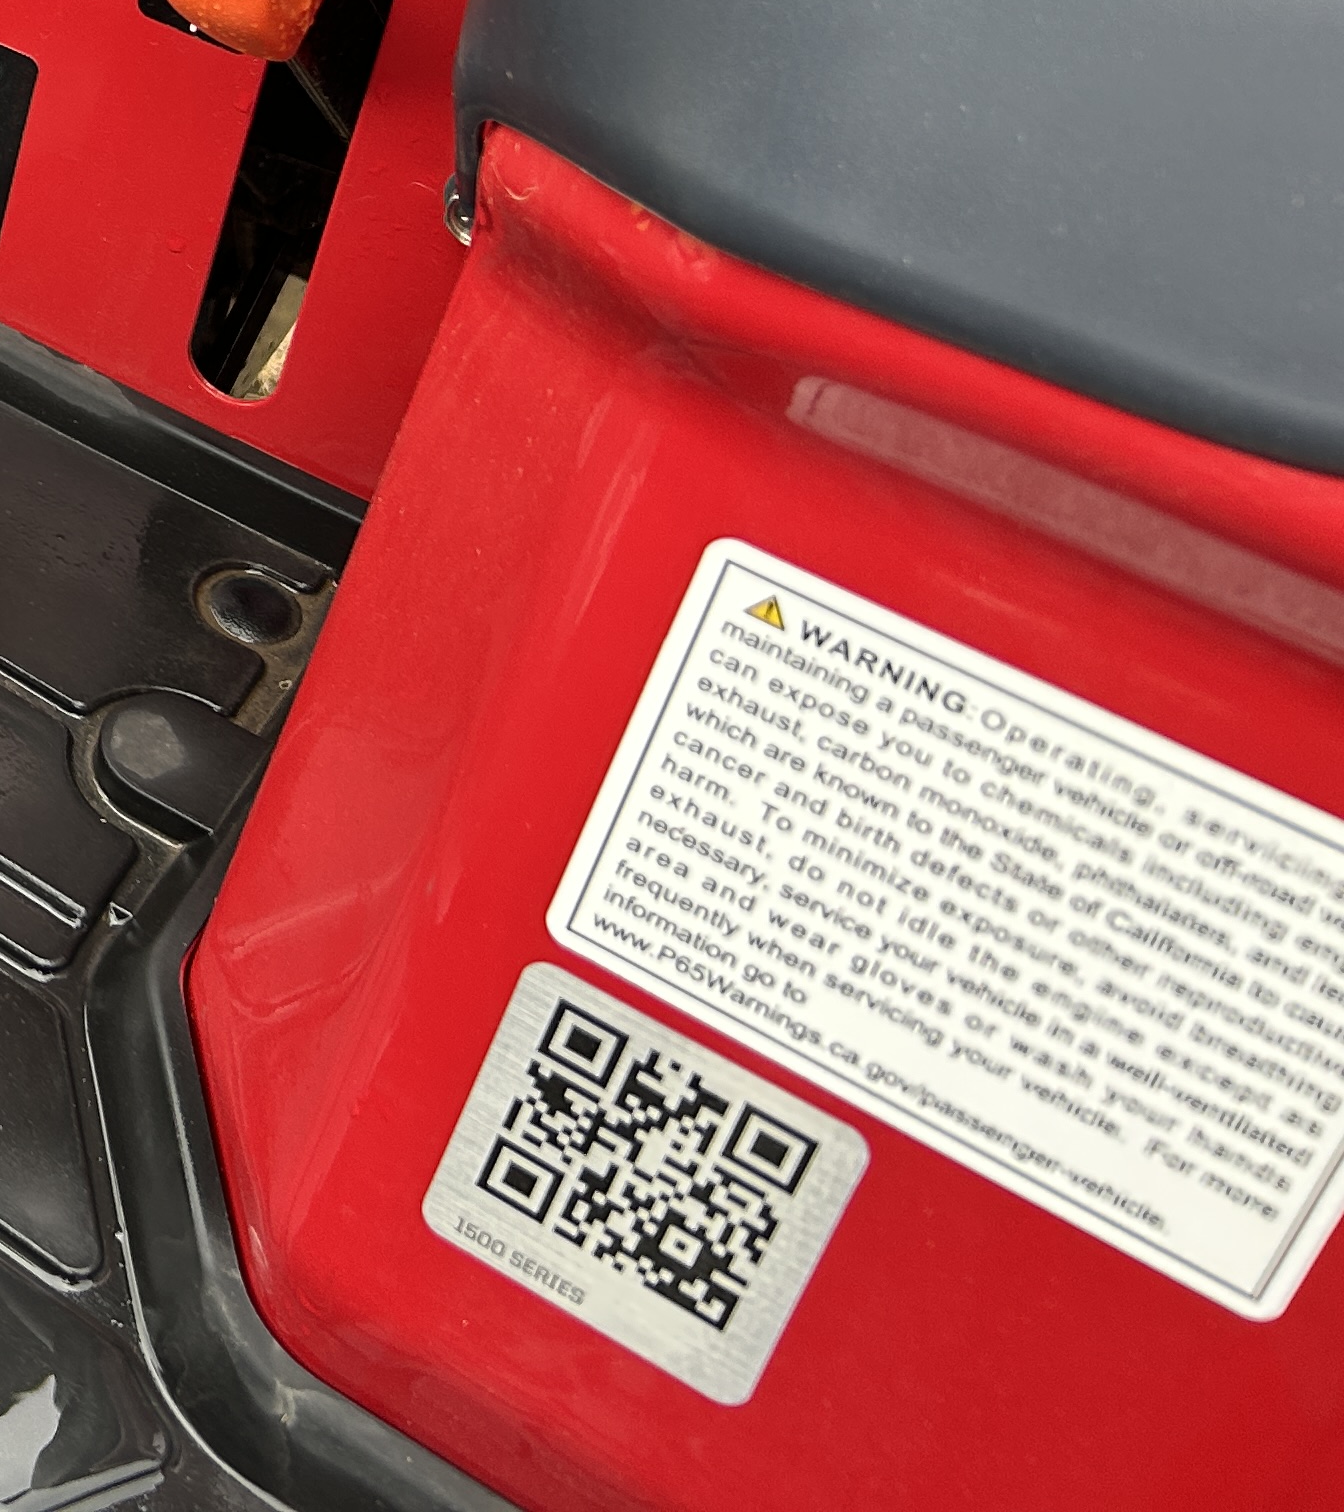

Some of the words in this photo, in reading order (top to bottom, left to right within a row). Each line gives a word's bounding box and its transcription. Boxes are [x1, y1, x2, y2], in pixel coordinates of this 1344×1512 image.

[709, 648, 758, 682] can
[767, 677, 870, 736] expose
[720, 620, 870, 705] maintaining
[673, 730, 766, 784] cancer
[773, 781, 829, 817] and
[834, 807, 901, 855] birth
[686, 702, 758, 749] which
[763, 743, 806, 772] are
[812, 762, 900, 819] known
[816, 735, 912, 791] carbon
[761, 800, 794, 833] To
[801, 828, 931, 902] minimize
[787, 855, 826, 882] do
[836, 879, 887, 915] not
[603, 883, 738, 968] information
[741, 963, 776, 988] go
[782, 980, 808, 1004] to
[615, 858, 740, 938] frequently
[747, 931, 816, 978] when
[822, 972, 945, 1048] servicing
[625, 837, 689, 879] area
[701, 876, 757, 913] and
[768, 909, 840, 955] wear
[848, 954, 952, 1016] gloves
[778, 883, 872, 940] service
[454, 1215, 506, 1257] 1500
[509, 1250, 585, 1305] SERIES
